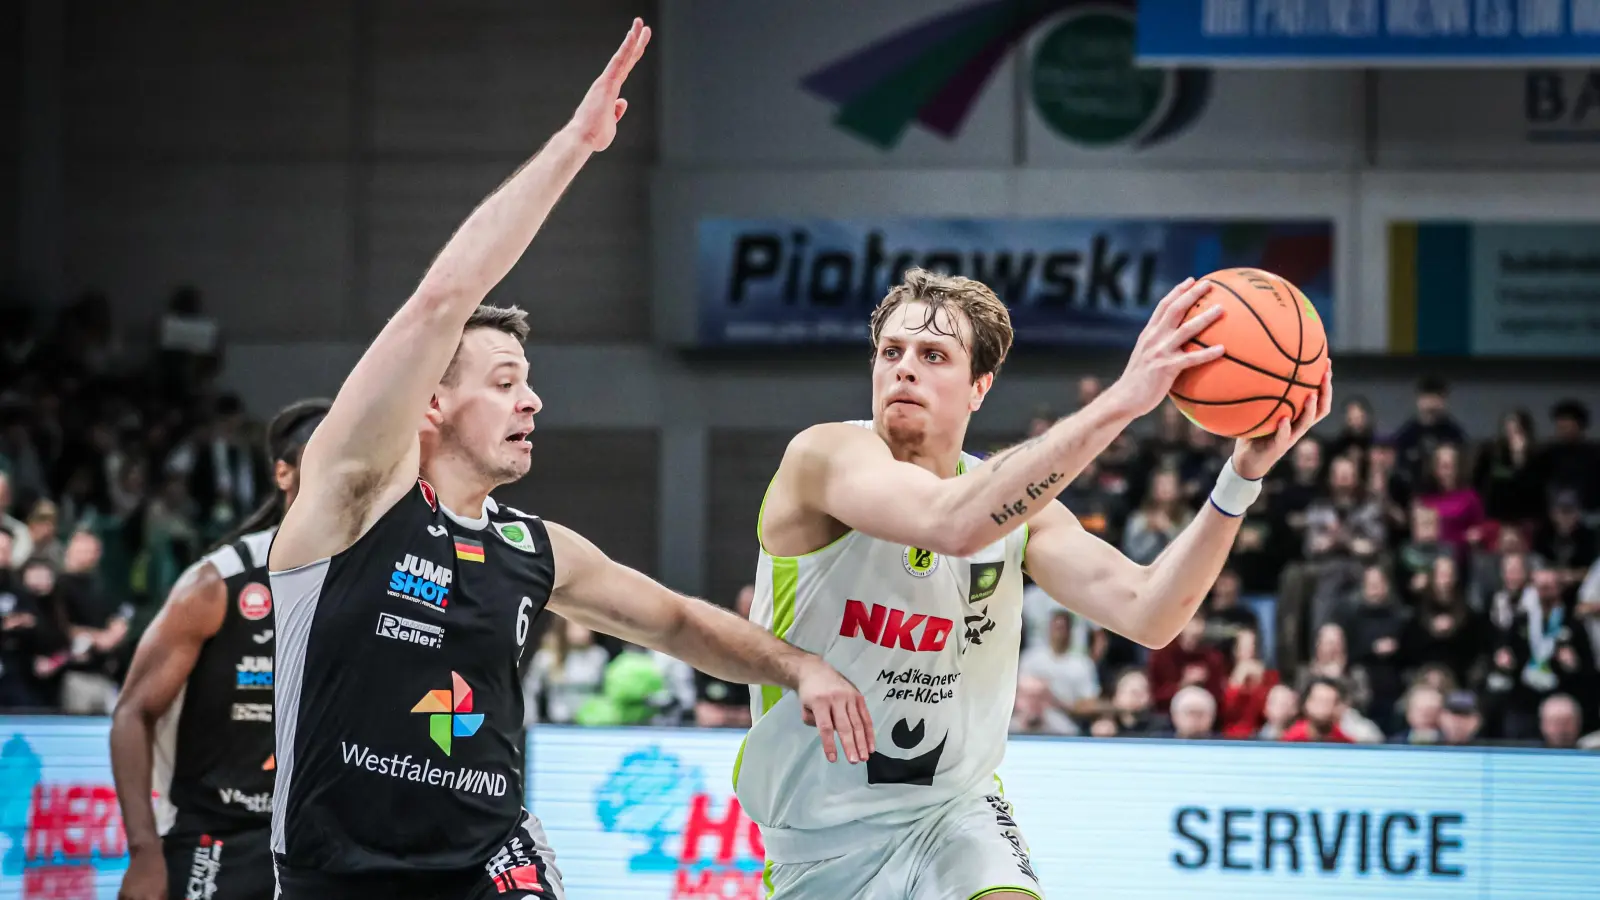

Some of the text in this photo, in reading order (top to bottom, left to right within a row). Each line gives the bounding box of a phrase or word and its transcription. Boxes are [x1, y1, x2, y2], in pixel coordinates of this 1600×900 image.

[990, 499, 1028, 526] big
[395, 553, 453, 588] JUMP
[516, 596, 533, 647] 6
[839, 598, 954, 653] NKD
[341, 741, 507, 797] WestfalenWIND
[1173, 806, 1467, 877] SERVICE
